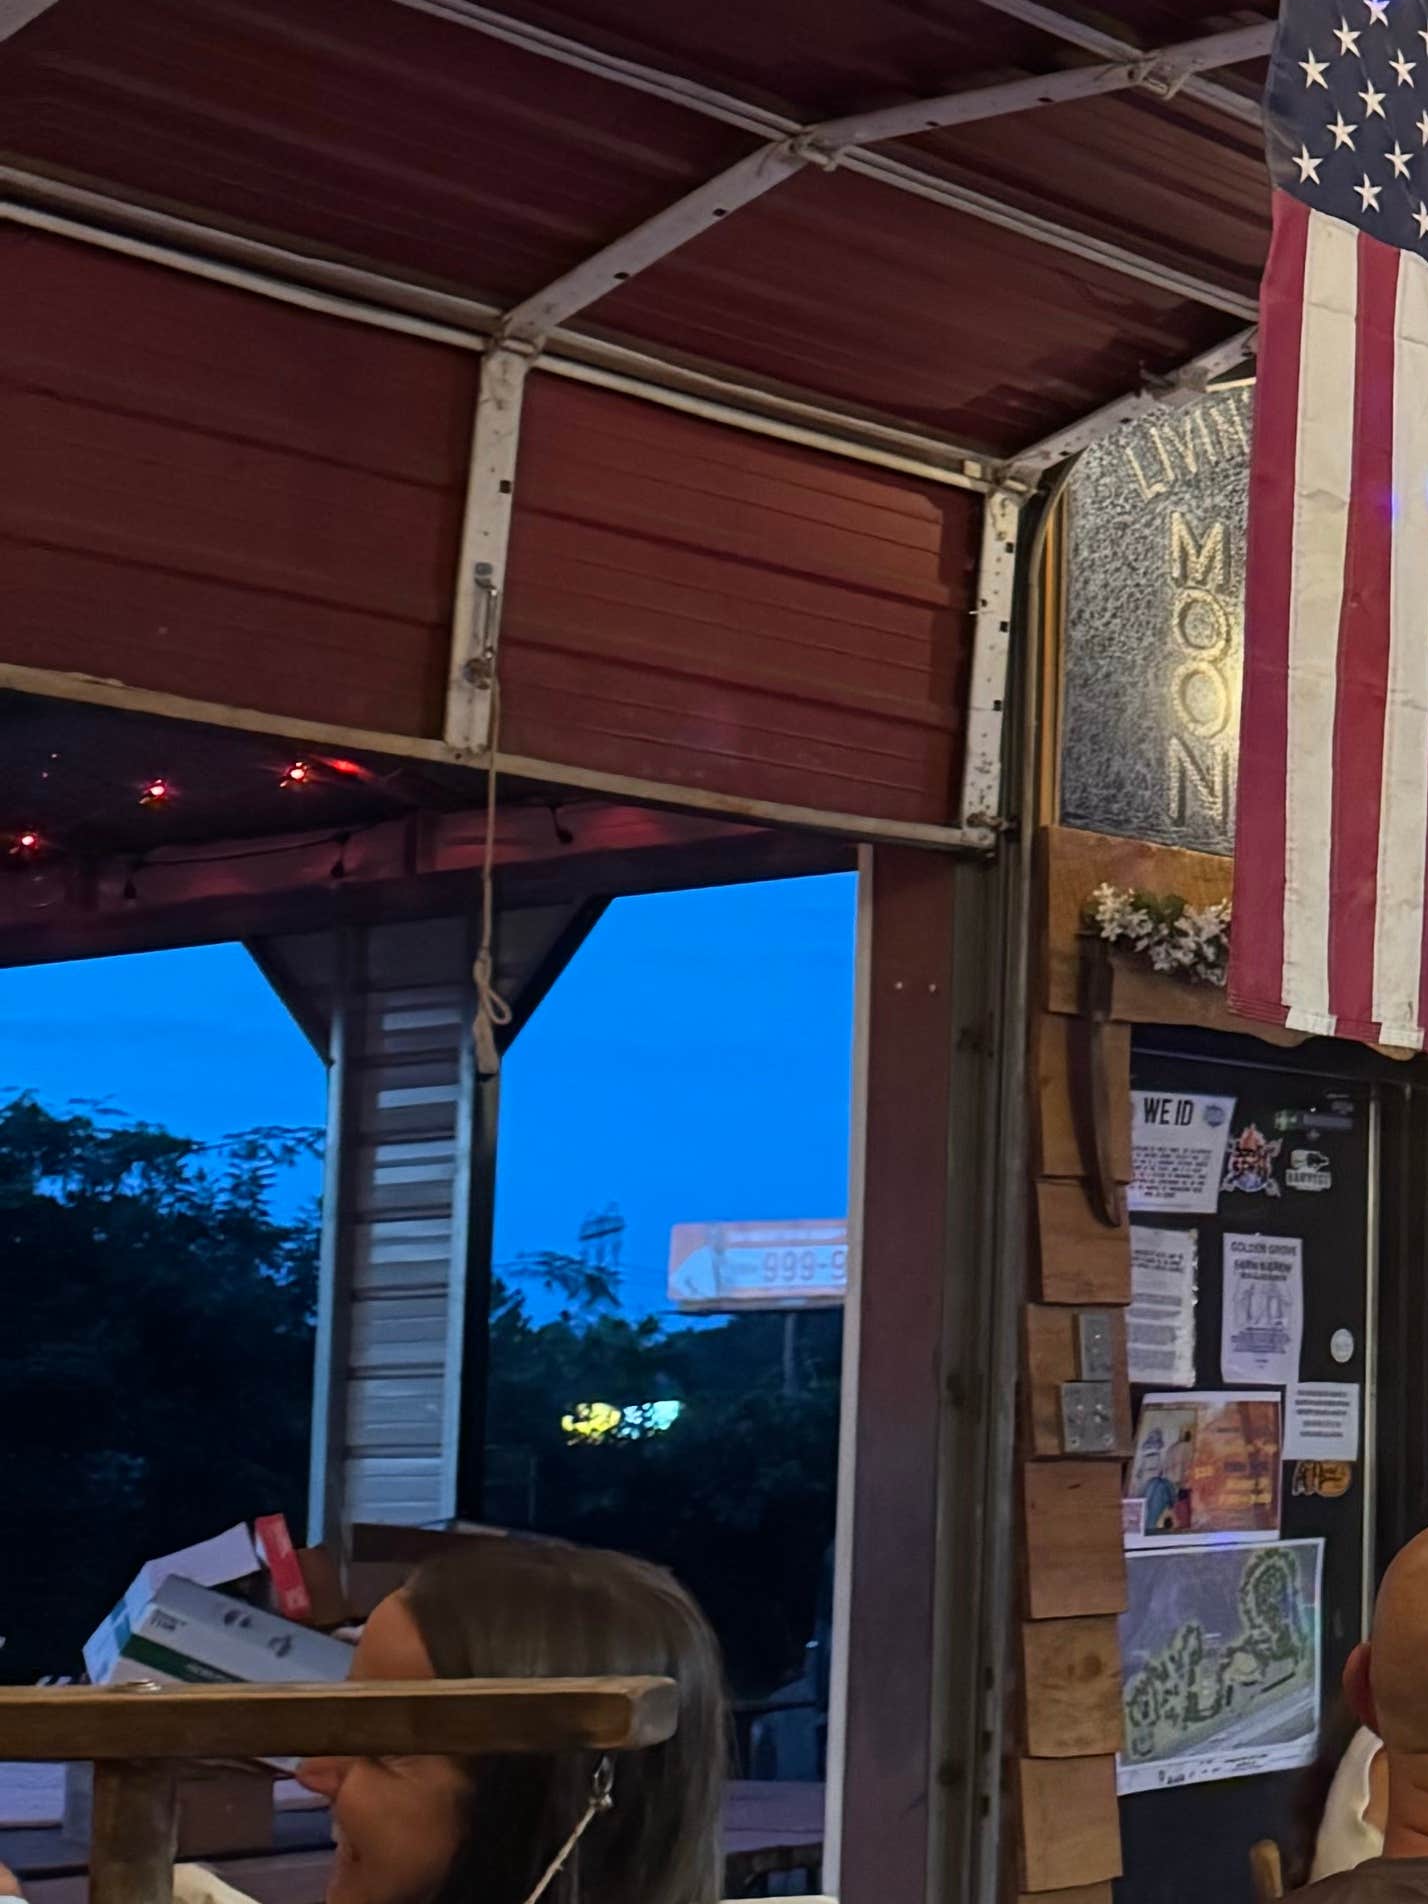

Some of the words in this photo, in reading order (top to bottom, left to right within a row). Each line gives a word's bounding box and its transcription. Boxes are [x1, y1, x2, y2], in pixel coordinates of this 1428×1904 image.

[1170, 510, 1231, 826] MOON
[1144, 1097, 1173, 1126] WE
[1175, 1099, 1195, 1127] ID
